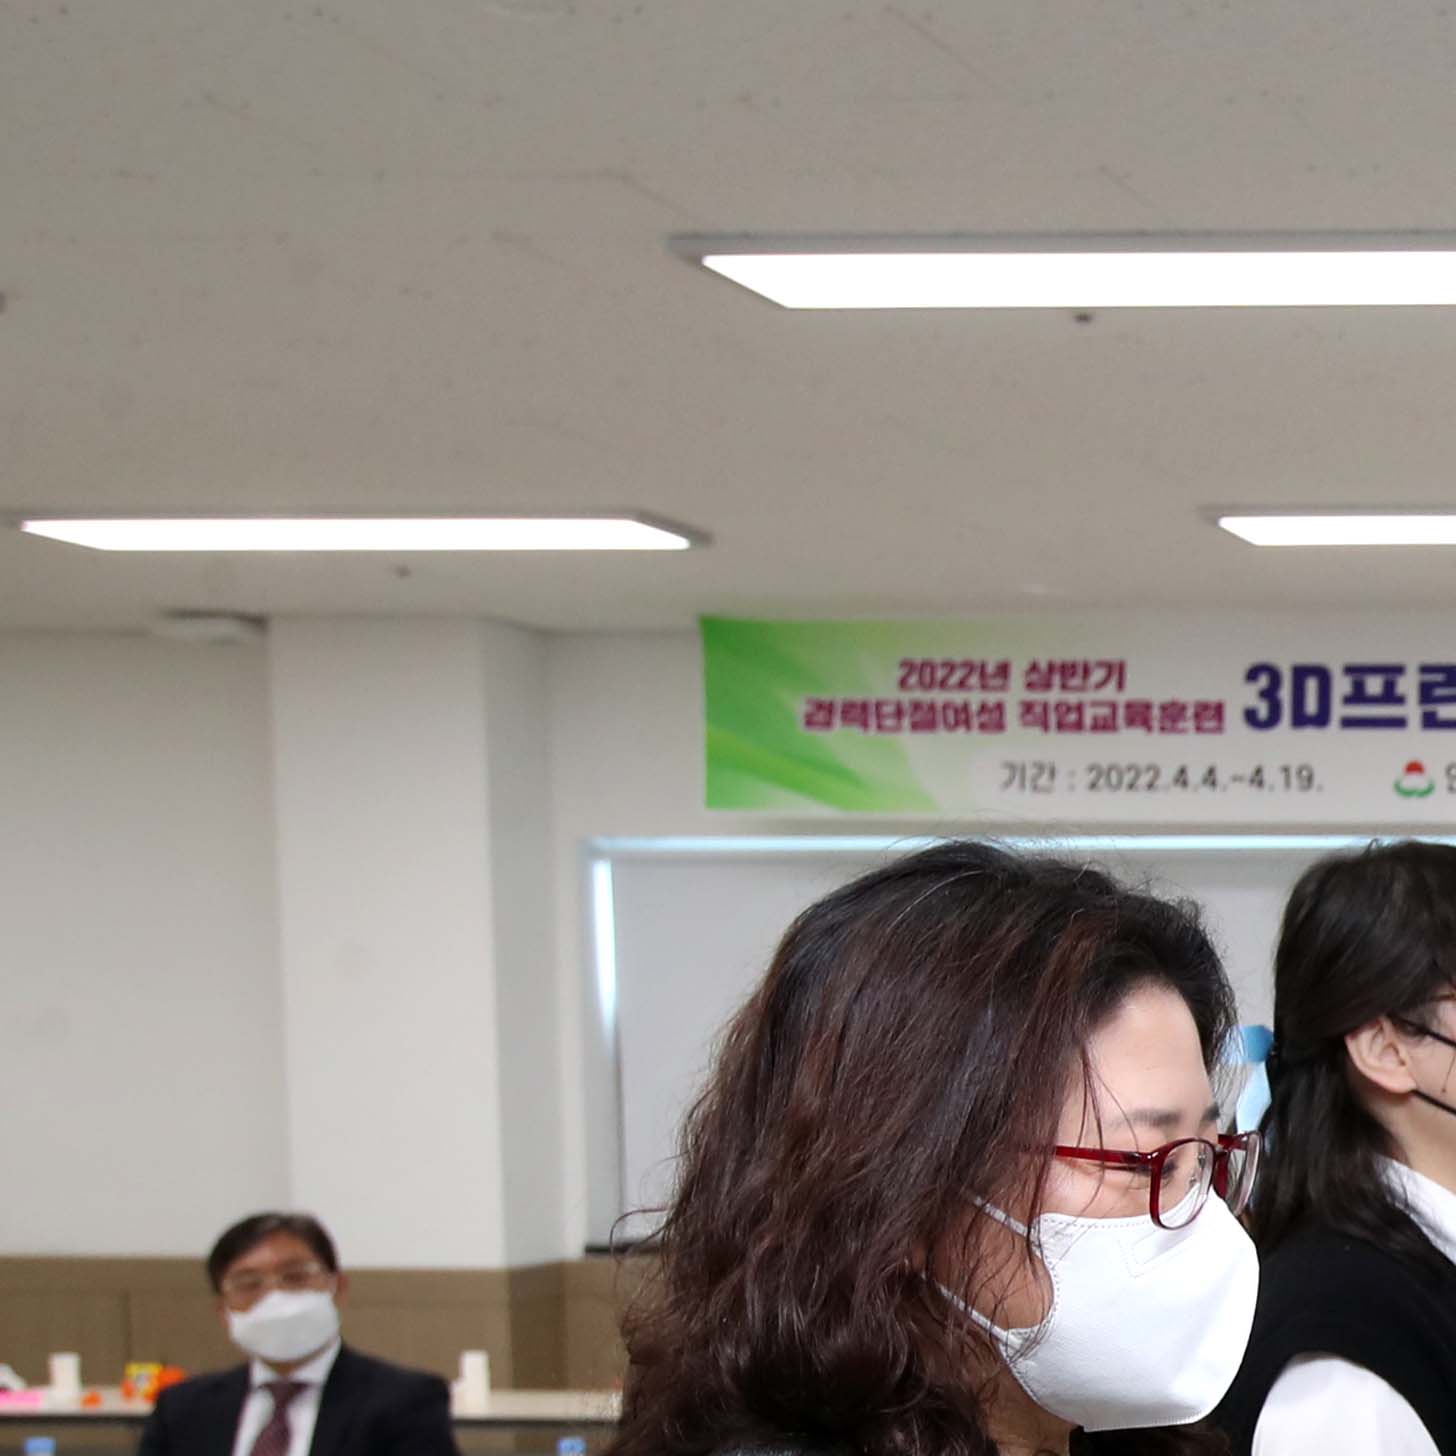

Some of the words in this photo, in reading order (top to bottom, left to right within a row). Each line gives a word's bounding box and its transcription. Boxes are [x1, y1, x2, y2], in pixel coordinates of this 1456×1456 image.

[898, 660, 1010, 691] 2022년
[1024, 660, 1126, 692] 상반기
[1001, 761, 1056, 793] 기간
